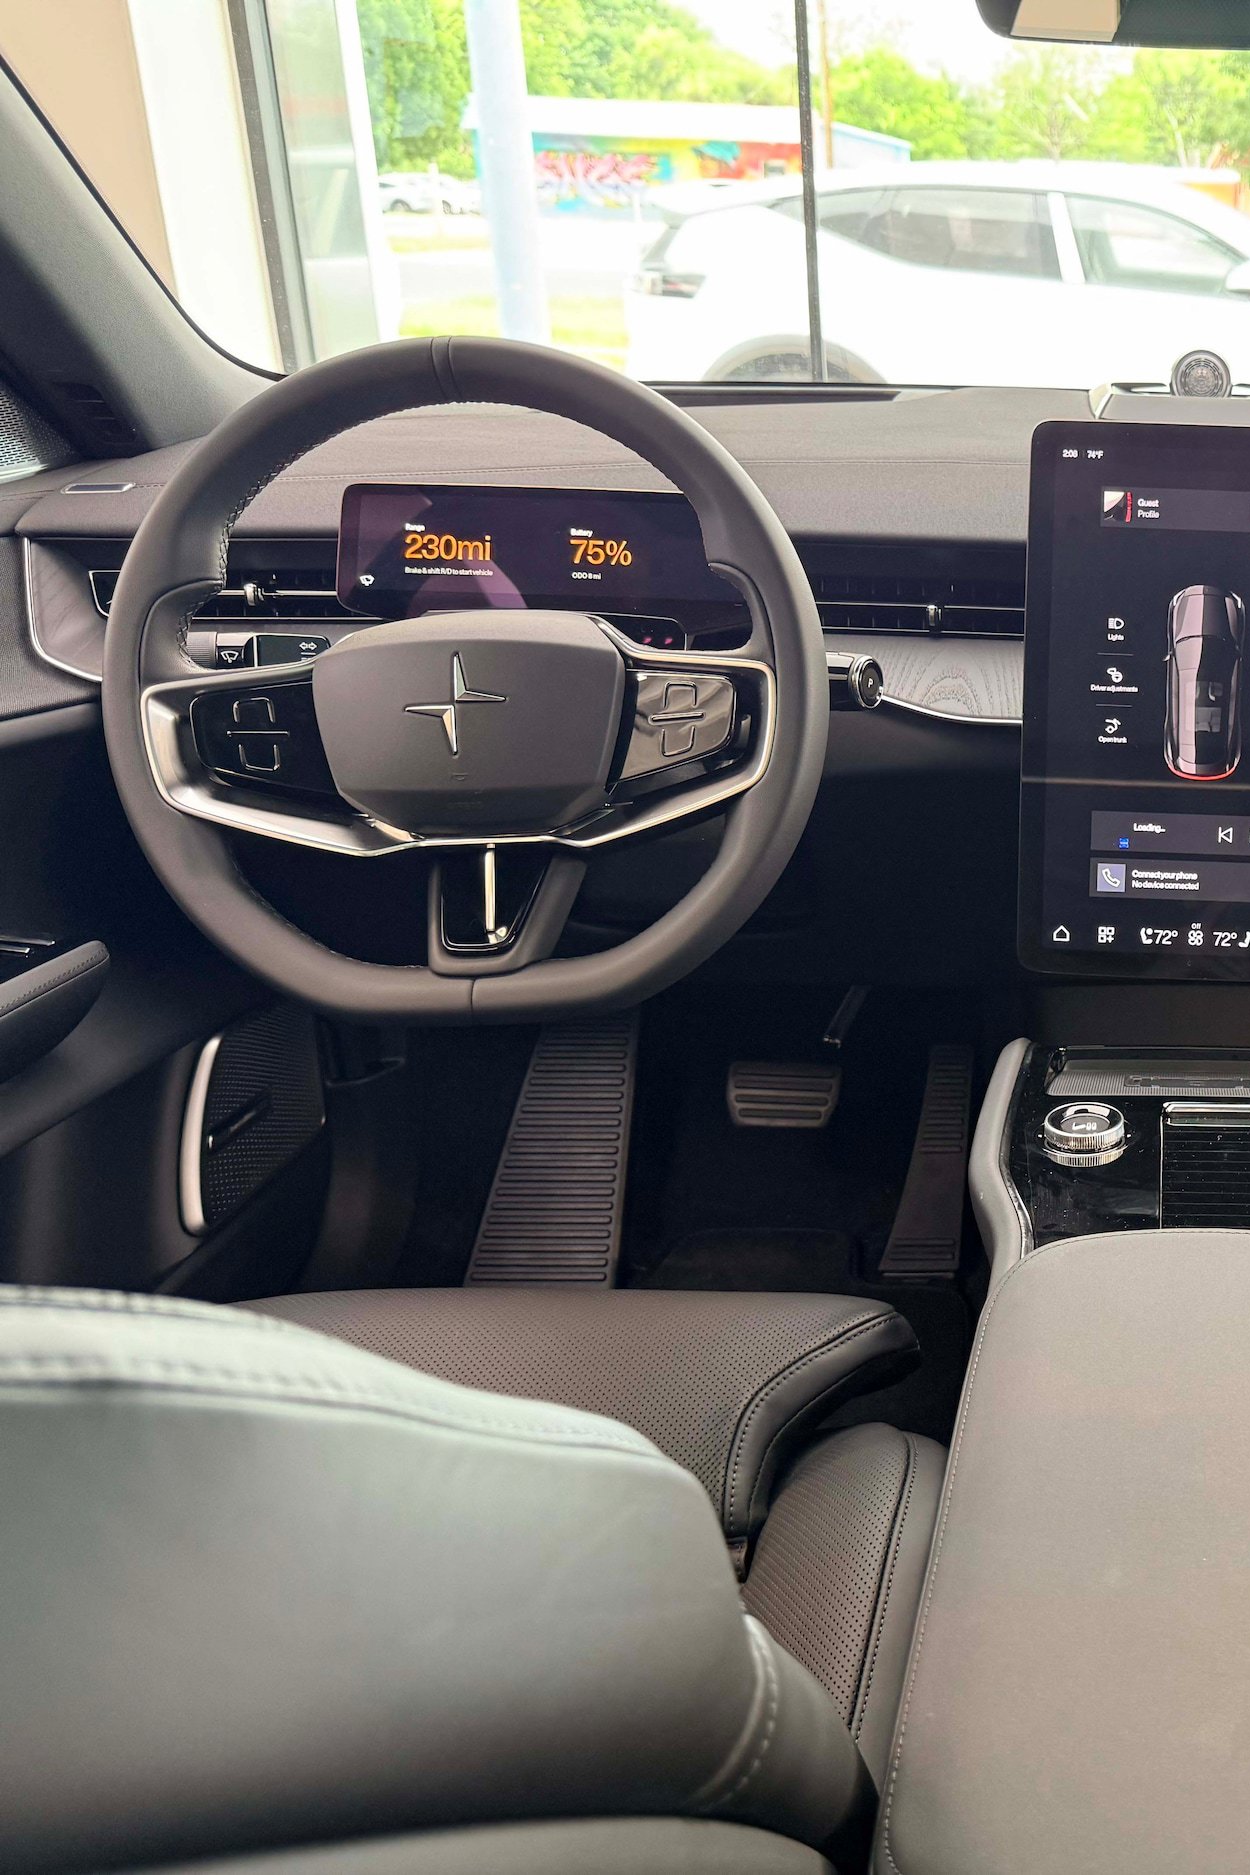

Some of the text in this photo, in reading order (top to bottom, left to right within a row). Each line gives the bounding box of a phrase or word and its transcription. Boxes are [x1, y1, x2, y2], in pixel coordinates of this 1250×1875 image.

[1137, 498, 1160, 508] Guest
[1137, 509, 1160, 519] Profile
[405, 523, 426, 532] Range
[570, 528, 593, 538] Battery
[569, 539, 632, 566] 75%
[459, 568, 472, 576] start
[1107, 633, 1124, 641] Lights
[868, 679, 874, 688] P
[1090, 684, 1138, 693] Driver adjustments
[1132, 869, 1198, 881] Connect your phone
[1131, 880, 1199, 890] No device connected
[1153, 929, 1178, 944] 72°
[1212, 931, 1237, 946] 72°
